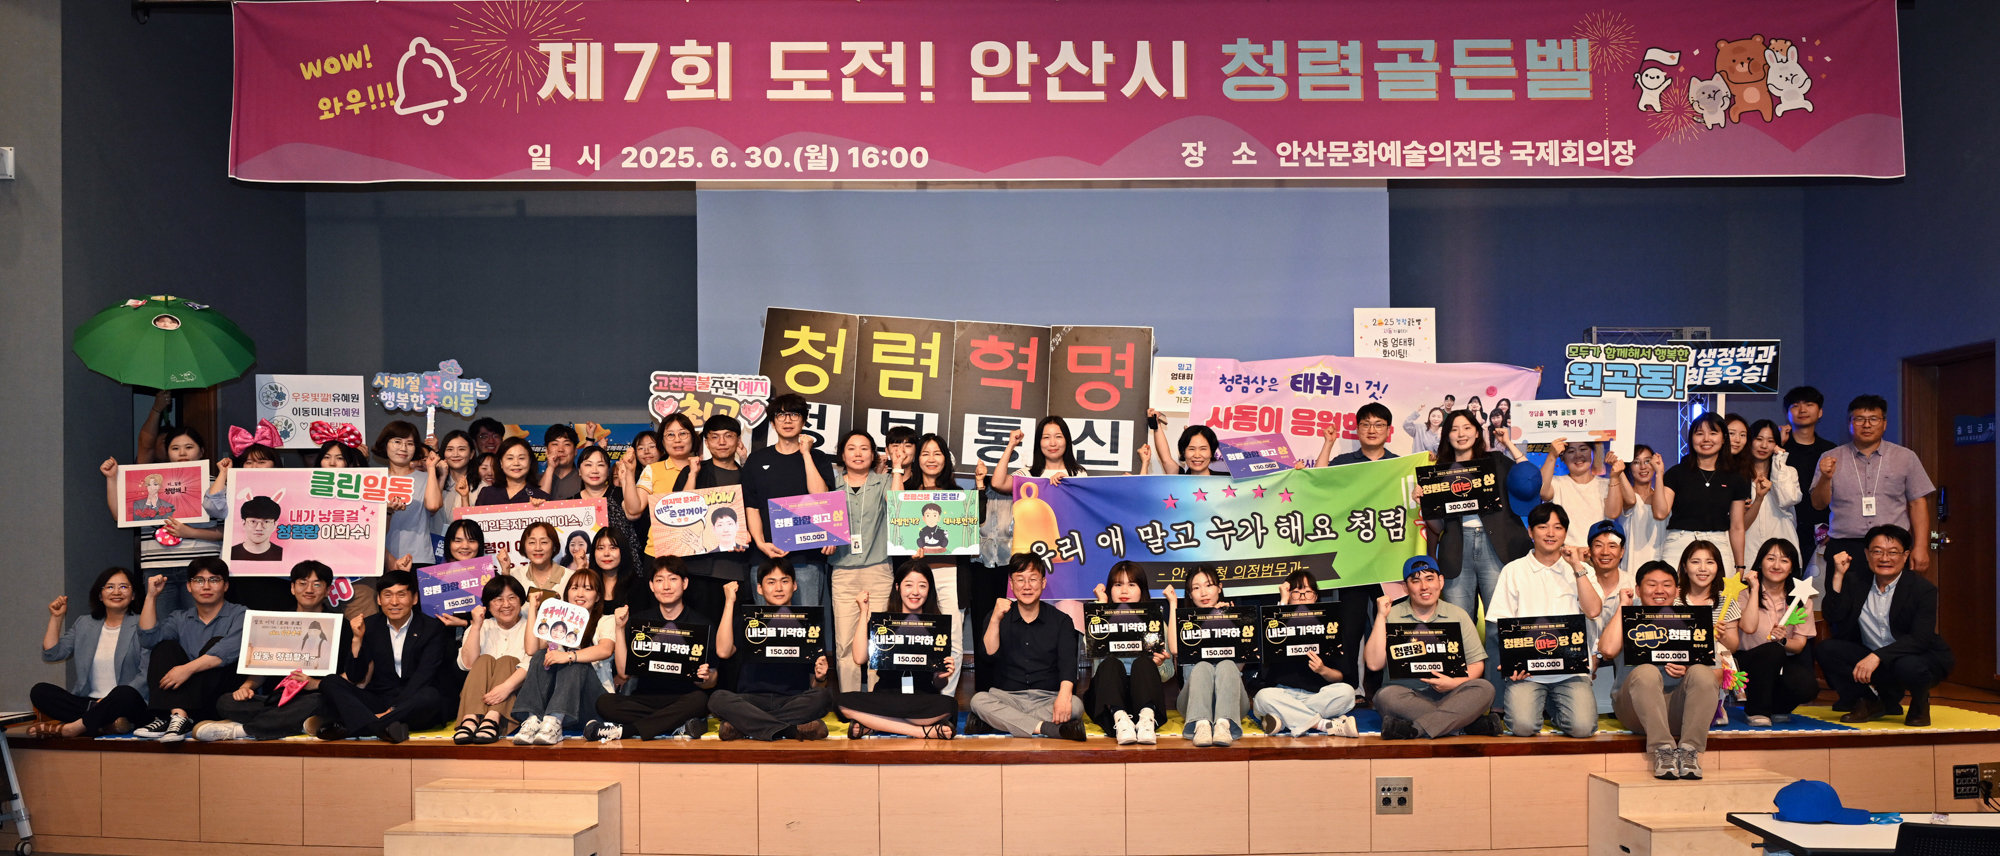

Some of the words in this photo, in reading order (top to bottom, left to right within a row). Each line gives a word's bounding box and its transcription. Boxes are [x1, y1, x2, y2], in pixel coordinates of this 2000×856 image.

[300, 44, 373, 81] WOW!
[536, 39, 733, 102] 제7회
[766, 40, 936, 103] 도전!
[970, 40, 1188, 103] 안산시
[1221, 37, 1594, 102] 청렴골든벨
[317, 82, 396, 121] 와우!!!
[847, 146, 930, 169] 16:00
[1276, 140, 1504, 168] 안산문화예술의전당
[1509, 140, 1636, 167] 국제회의장
[1568, 345, 1602, 359] 모두가
[1604, 345, 1653, 361] 함께해서
[1654, 347, 1691, 361] 행복한
[1689, 345, 1777, 368] 생정책과
[373, 375, 421, 393] 사계절
[1218, 373, 1280, 394] 청렴상은
[1365, 380, 1389, 401] 것!
[1567, 361, 1689, 400] 원곡동!
[380, 390, 424, 410] 행복한
[441, 393, 475, 415] 이동
[1175, 396, 1192, 404] 가즈
[1205, 404, 1284, 434] 사동이
[703, 491, 736, 506] WOW
[1448, 502, 1476, 511] 300,000
[288, 509, 316, 523] 내가
[277, 524, 320, 540] 청렴왕
[320, 523, 371, 540] 이희수!
[798, 533, 826, 543] 150,000
[1030, 531, 1085, 574] 우리
[1096, 523, 1126, 557] 애
[1136, 515, 1201, 554] 말고
[1206, 511, 1269, 549] 누가
[1275, 509, 1338, 545] 해요
[1348, 506, 1408, 543] 청렴
[1172, 565, 1228, 582] 안청
[1635, 629, 1664, 641] 언제나
[1692, 628, 1708, 641] 상
[1530, 660, 1561, 668] 300,000
[1655, 652, 1687, 660] 400,000
[653, 663, 680, 671] 150,000
